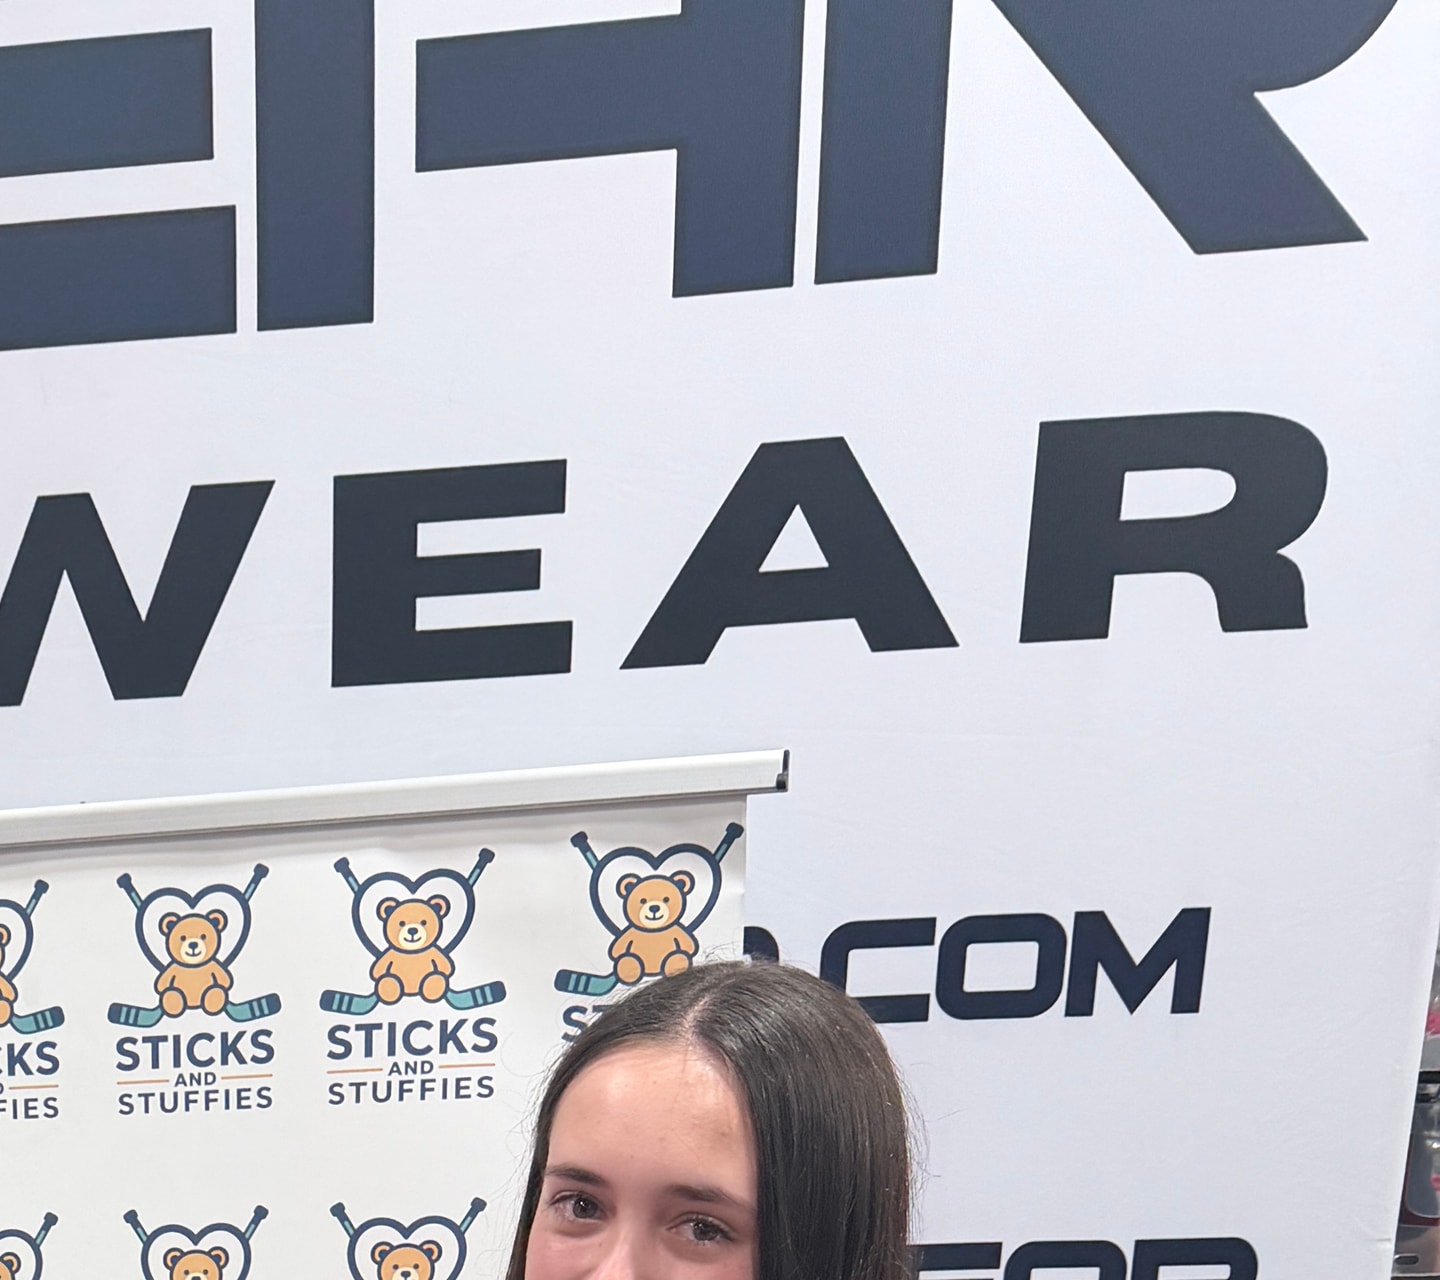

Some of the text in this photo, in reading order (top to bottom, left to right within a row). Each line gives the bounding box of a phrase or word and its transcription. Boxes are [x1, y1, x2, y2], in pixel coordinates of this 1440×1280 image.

[116, 1028, 276, 1072] STICKS
[327, 1017, 498, 1061] STICKS
[174, 1072, 217, 1087] AND
[387, 1060, 435, 1076] AND
[118, 1087, 273, 1115] STUFFIES
[327, 1075, 495, 1106] STUFFIES
